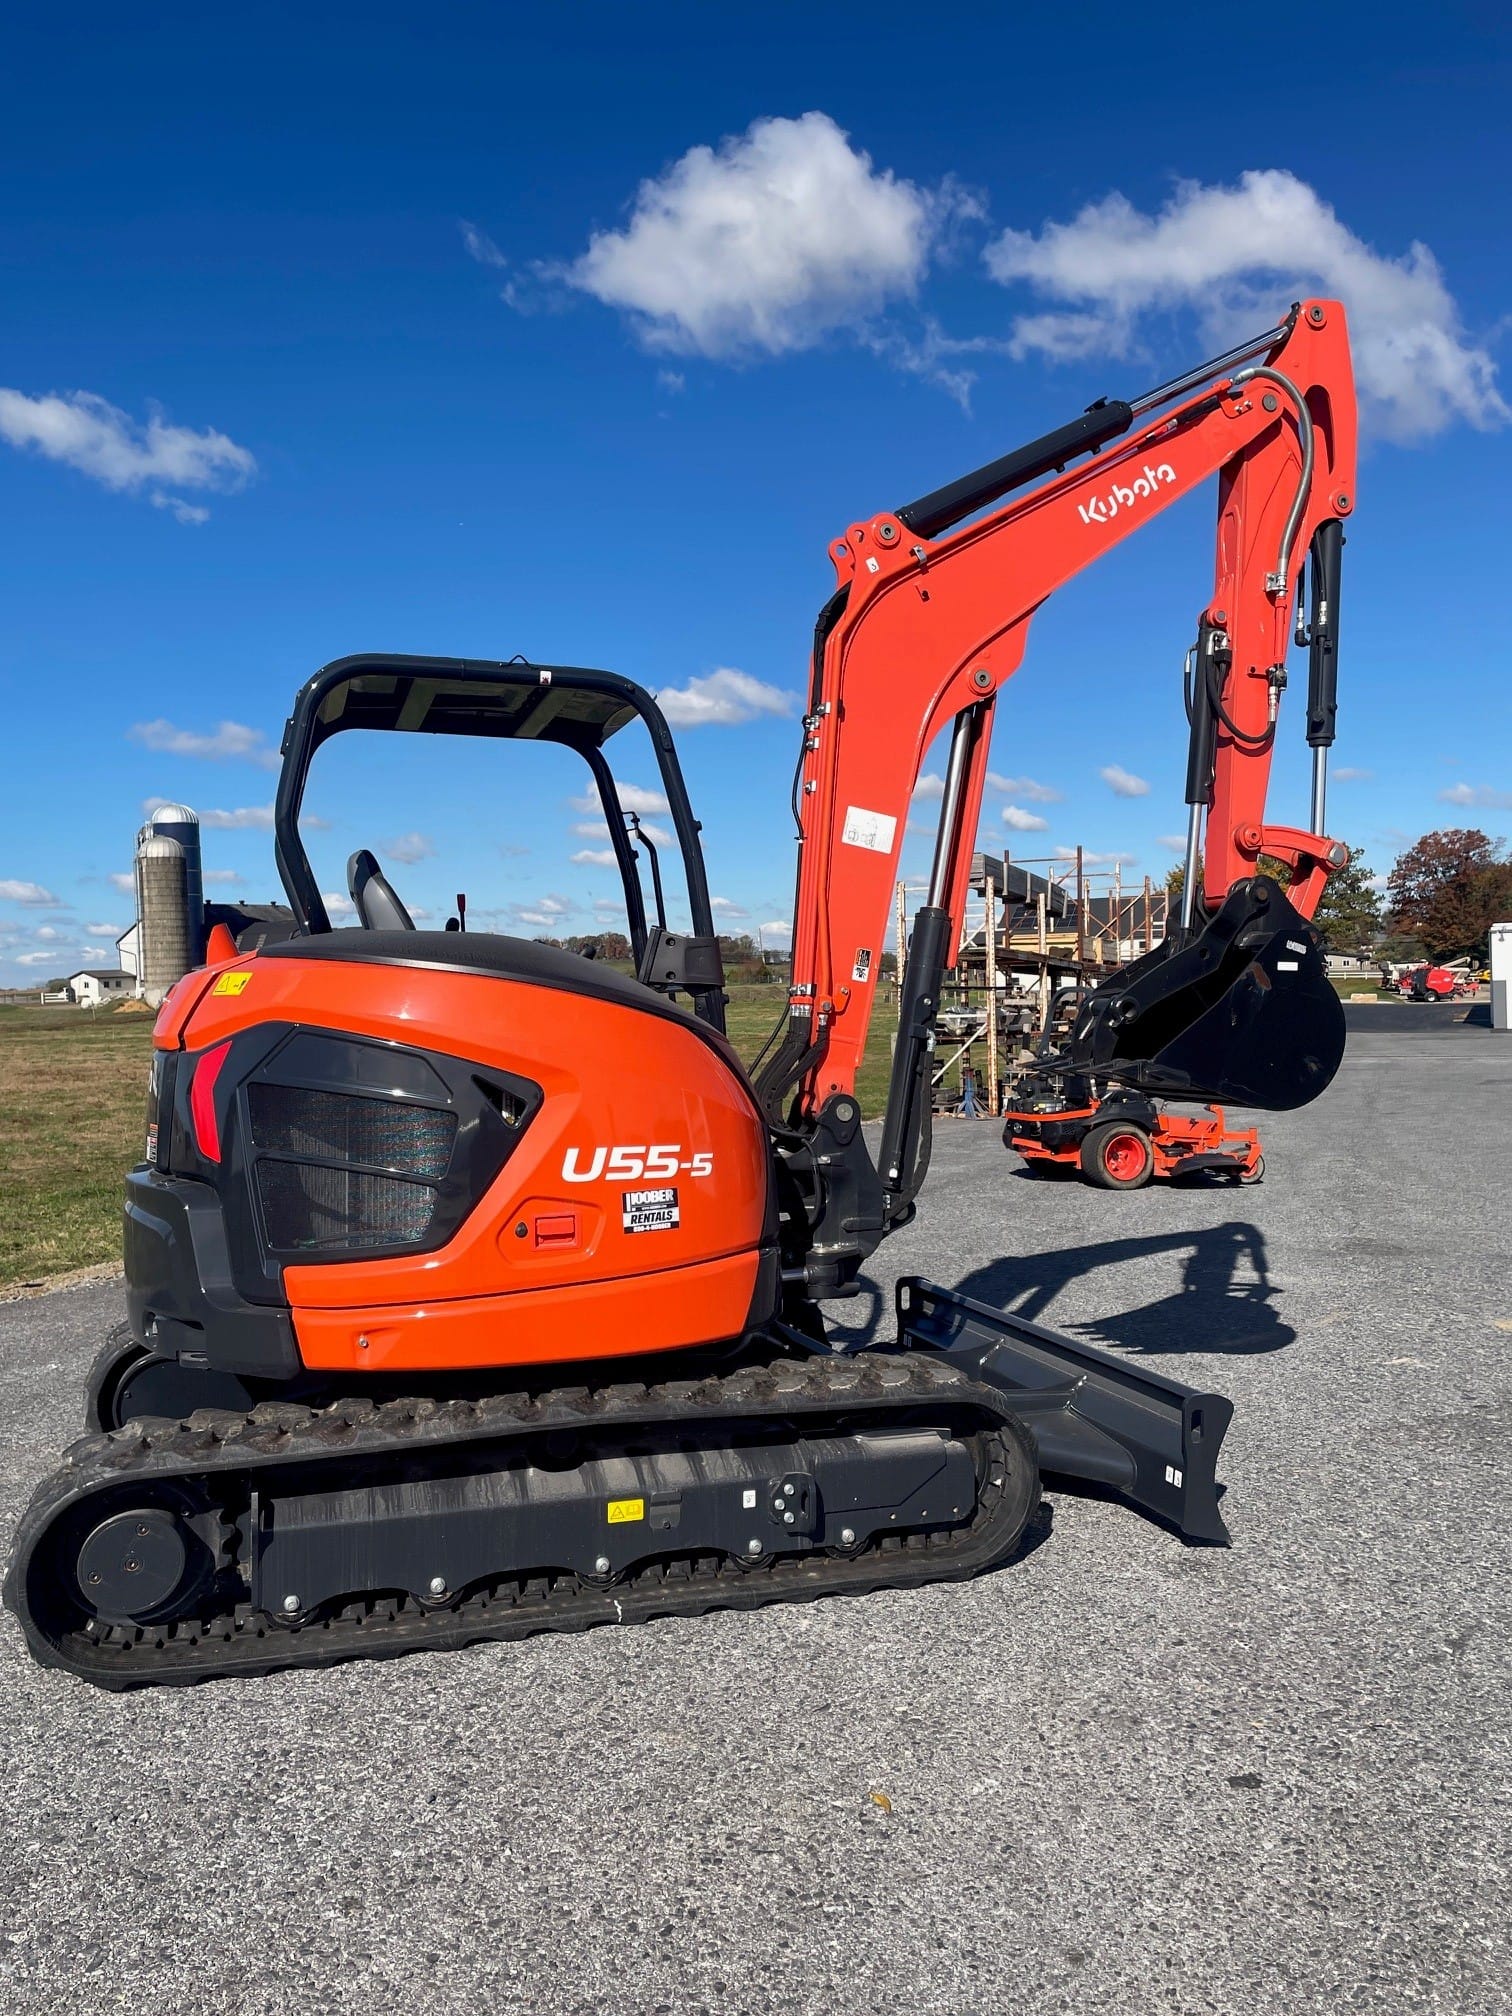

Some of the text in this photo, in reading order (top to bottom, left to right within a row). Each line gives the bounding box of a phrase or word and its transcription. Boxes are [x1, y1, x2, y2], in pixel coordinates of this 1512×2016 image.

[1077, 464, 1177, 524] Kubota
[561, 1145, 714, 1183] U55-5
[630, 1210, 673, 1225] RENTALS
